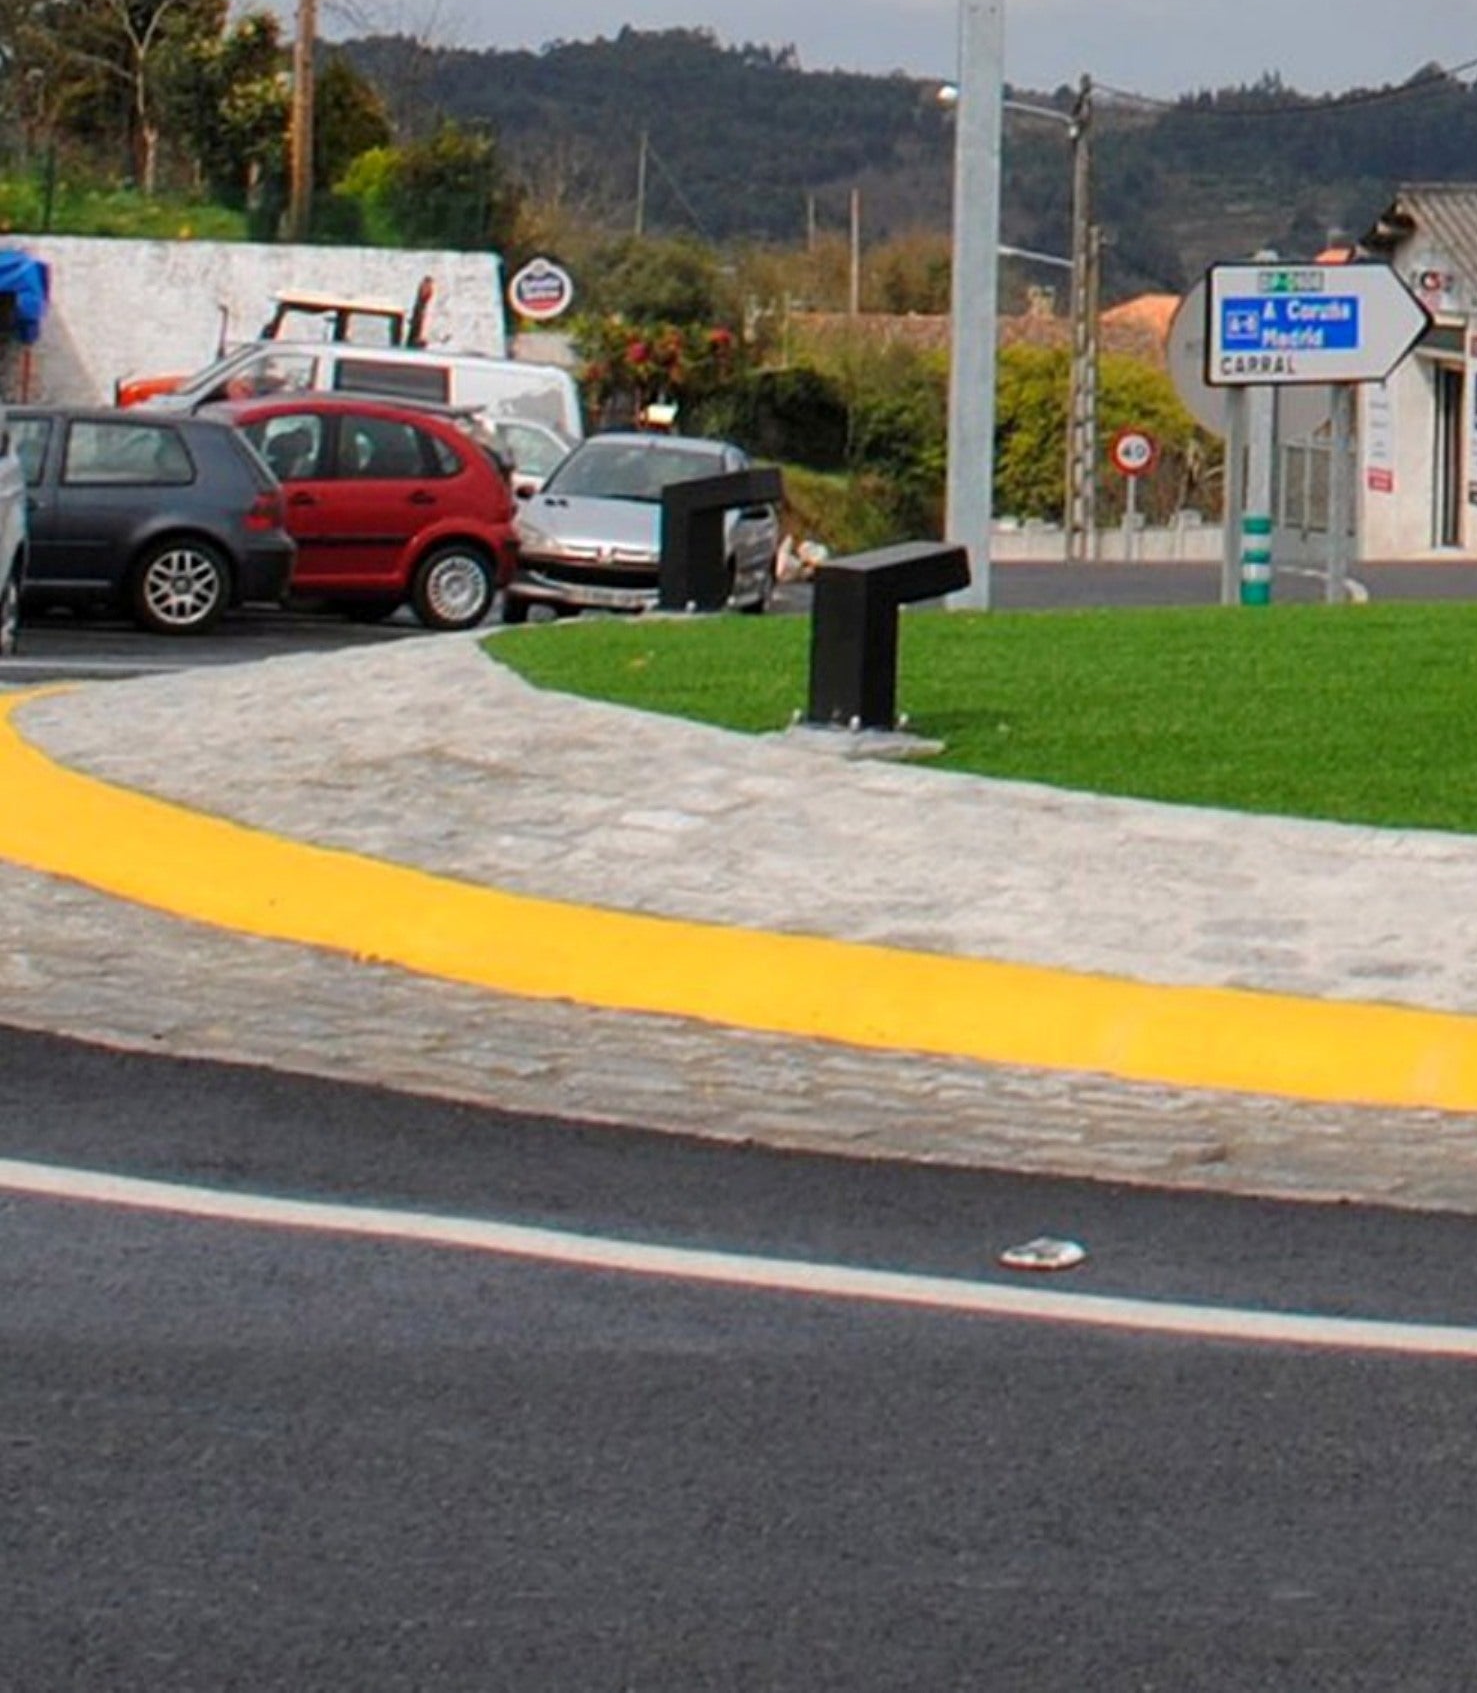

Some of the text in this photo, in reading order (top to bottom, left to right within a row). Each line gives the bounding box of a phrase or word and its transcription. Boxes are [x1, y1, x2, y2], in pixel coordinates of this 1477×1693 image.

[1262, 299, 1351, 321] A Coruña
[1261, 326, 1324, 347] Madrid
[1220, 355, 1296, 375] CARRAL
